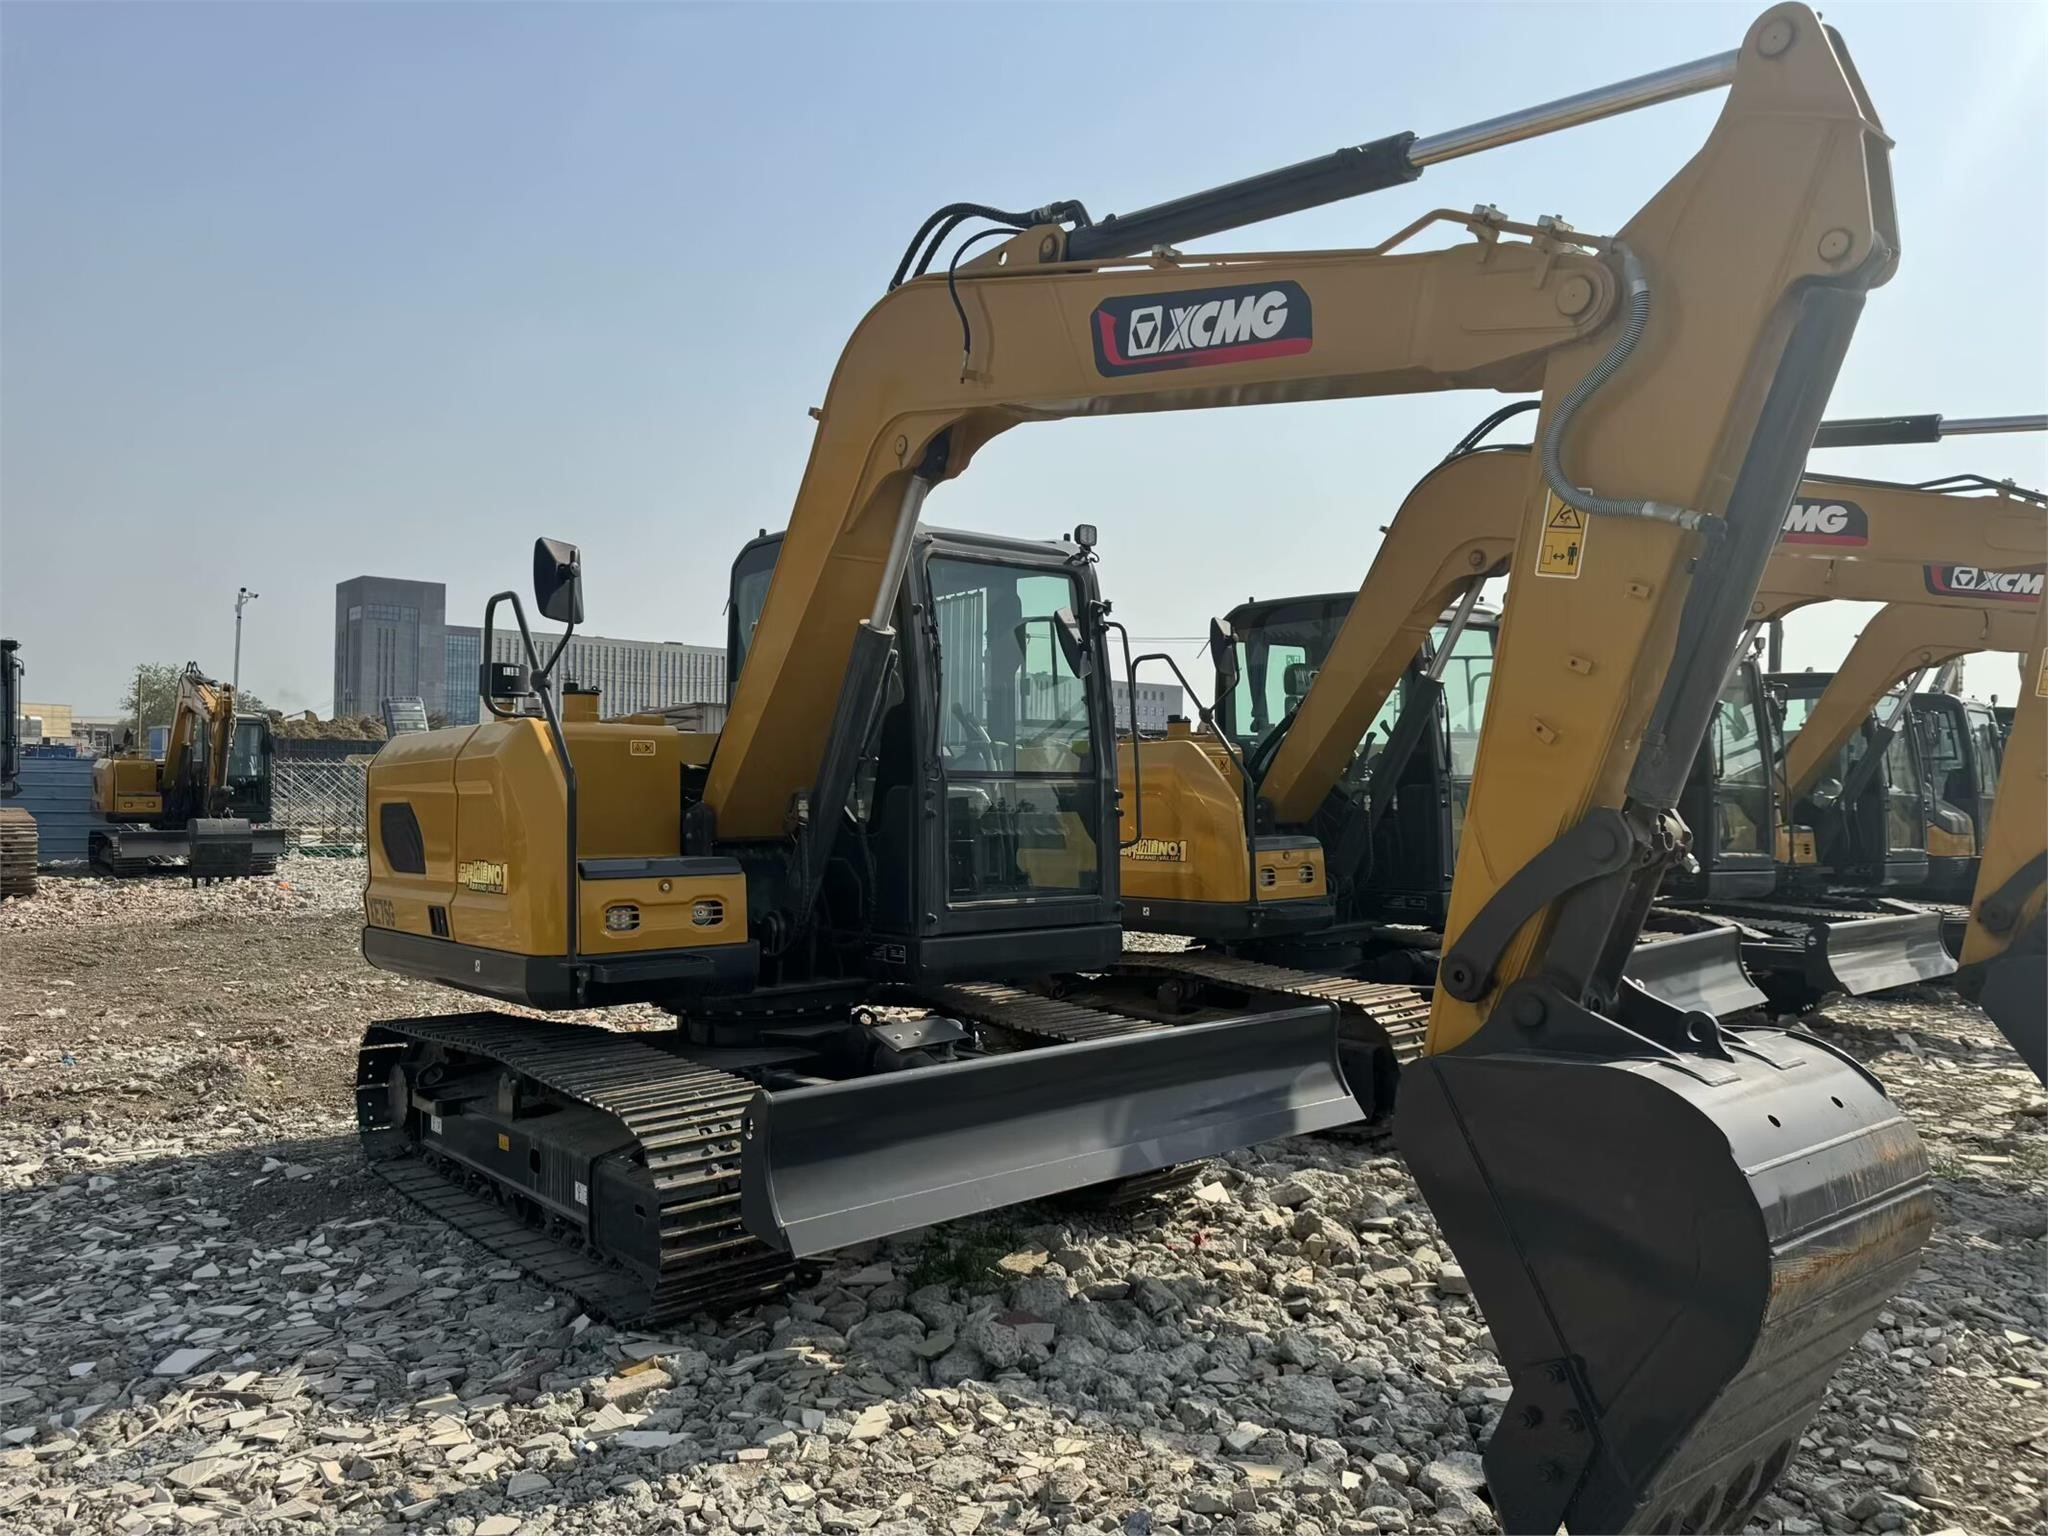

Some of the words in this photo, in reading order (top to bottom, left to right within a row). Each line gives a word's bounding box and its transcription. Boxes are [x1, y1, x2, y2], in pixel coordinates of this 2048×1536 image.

[1159, 290, 1288, 352] XCMG
[1783, 504, 1849, 533] MG
[1976, 570, 2045, 594] XCM
